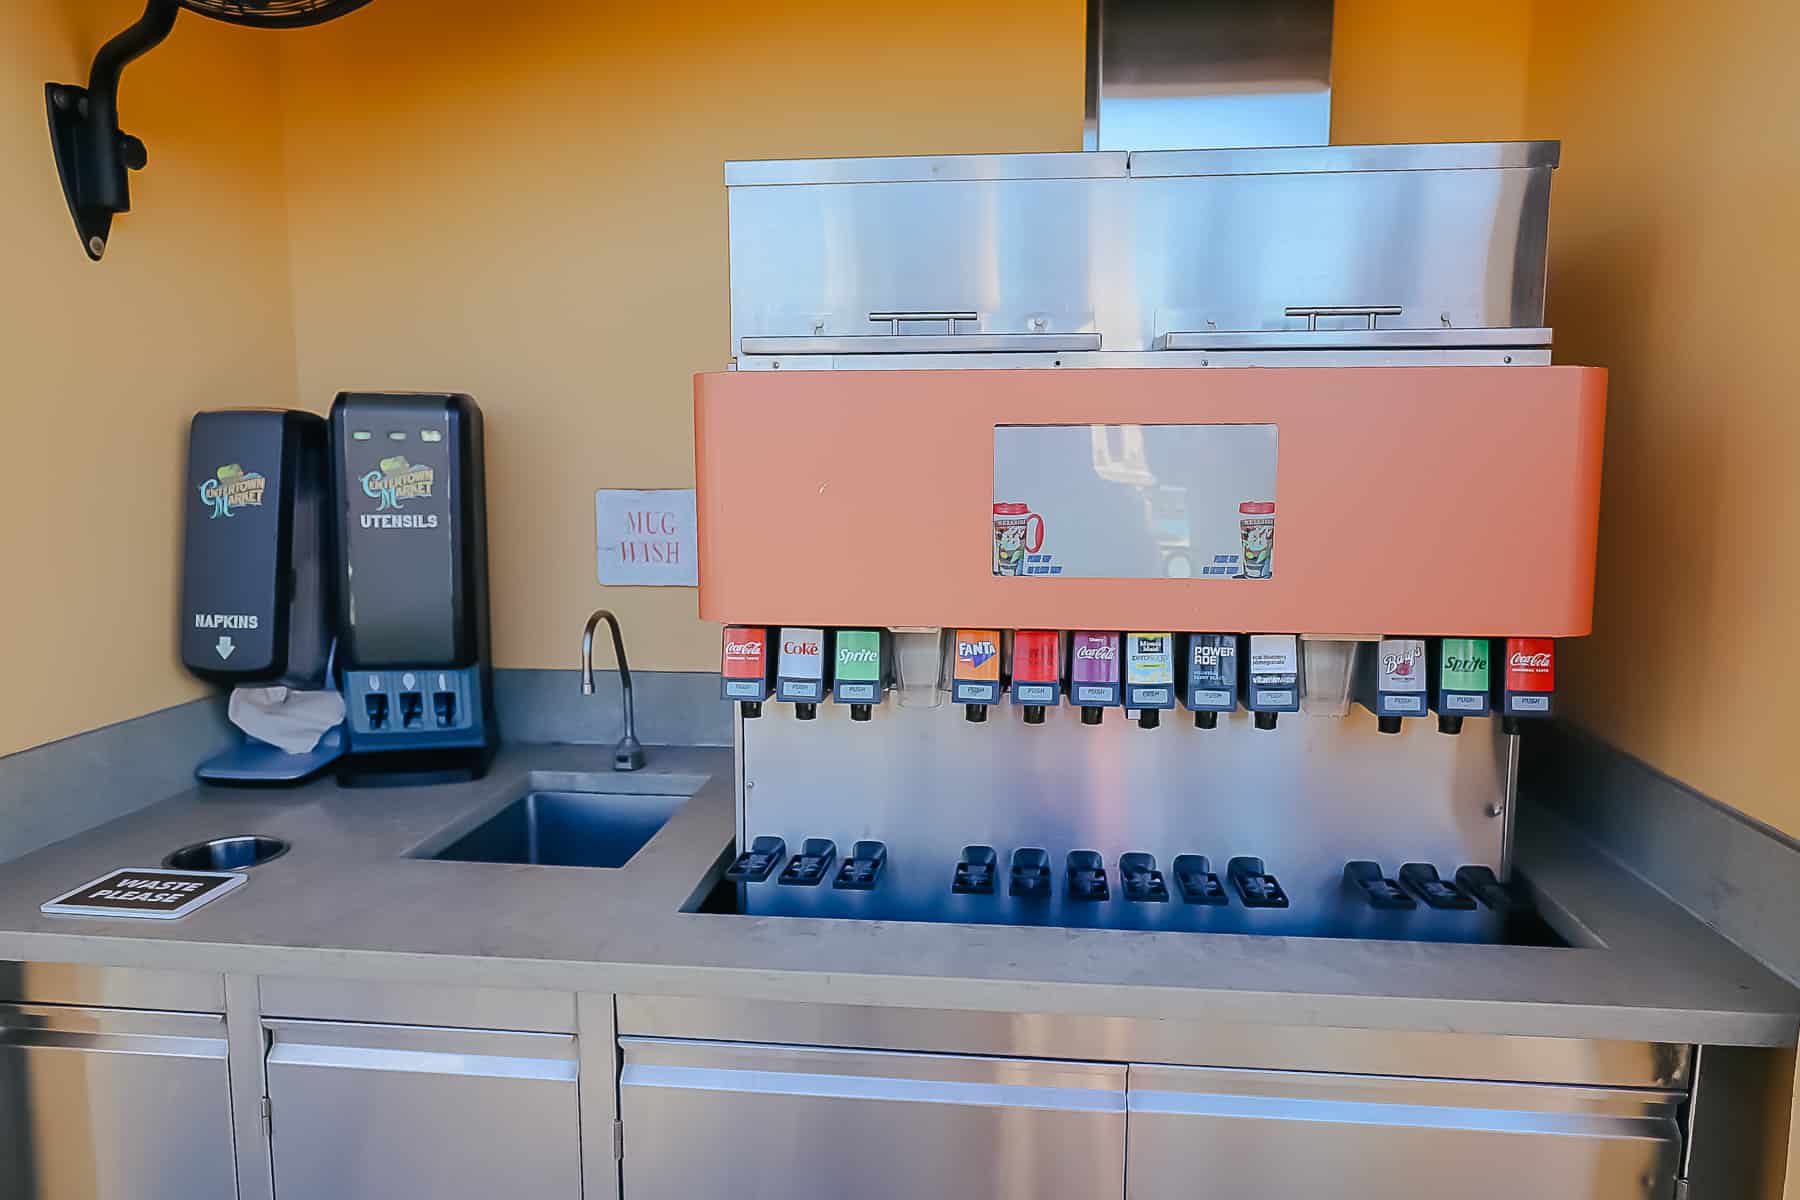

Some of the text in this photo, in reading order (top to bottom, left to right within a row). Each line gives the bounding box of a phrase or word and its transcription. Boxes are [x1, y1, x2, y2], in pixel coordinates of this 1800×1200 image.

[360, 514, 438, 529] UTENSILS
[624, 510, 675, 535] MUG
[619, 541, 680, 564] WASH
[195, 614, 258, 630] NAPKINS
[726, 641, 762, 655] Coca-Cola
[959, 641, 997, 657] FANTA
[1077, 646, 1115, 660] Coca-Cola
[1194, 646, 1234, 657] POWER
[839, 648, 877, 664] Sprite
[1194, 655, 1217, 665] ADE
[1383, 647, 1422, 674] Barq's
[1445, 656, 1487, 671] Sprite
[1510, 652, 1552, 666] Coca-Cola
[116, 878, 204, 893] WASTE
[88, 889, 185, 903] PLEASE
